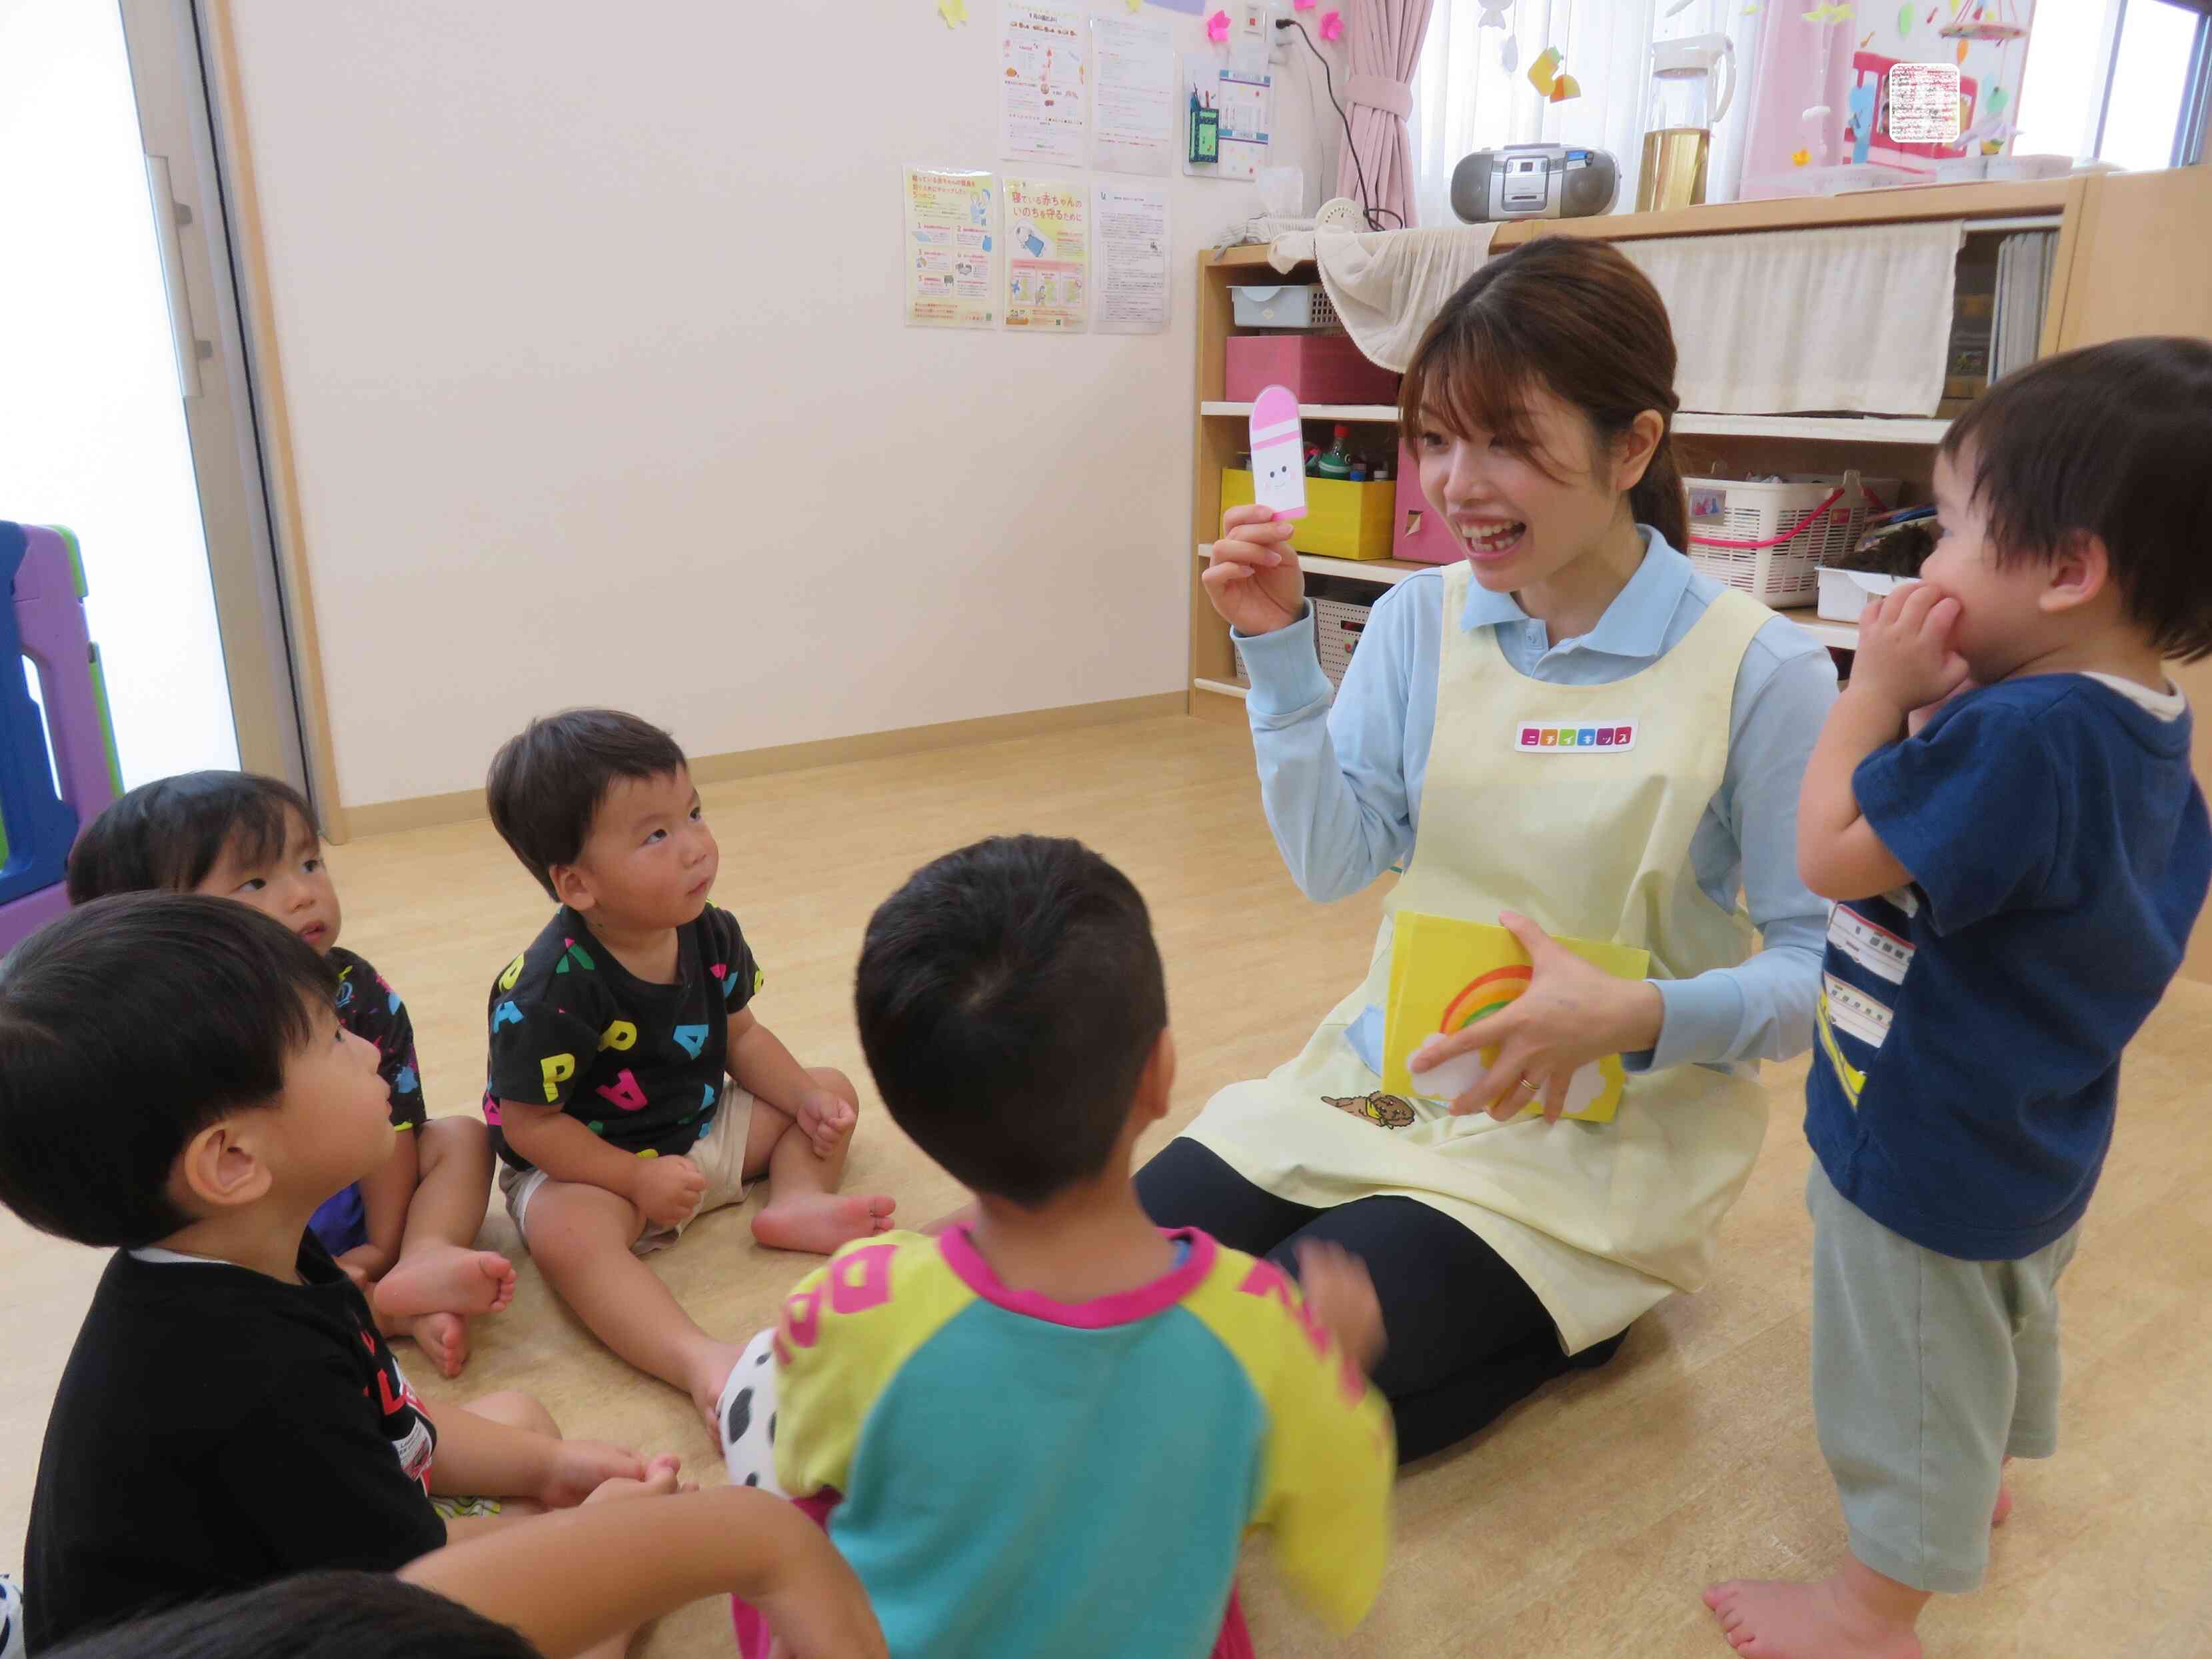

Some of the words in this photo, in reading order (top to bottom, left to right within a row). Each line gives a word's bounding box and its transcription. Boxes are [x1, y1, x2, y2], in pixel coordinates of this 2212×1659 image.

[1012, 191, 1082, 208] 寝ている赤ちゃんの
[1013, 207, 1082, 222] いのちを守るために
[540, 1052, 575, 1103] P
[594, 1068, 648, 1111] A
